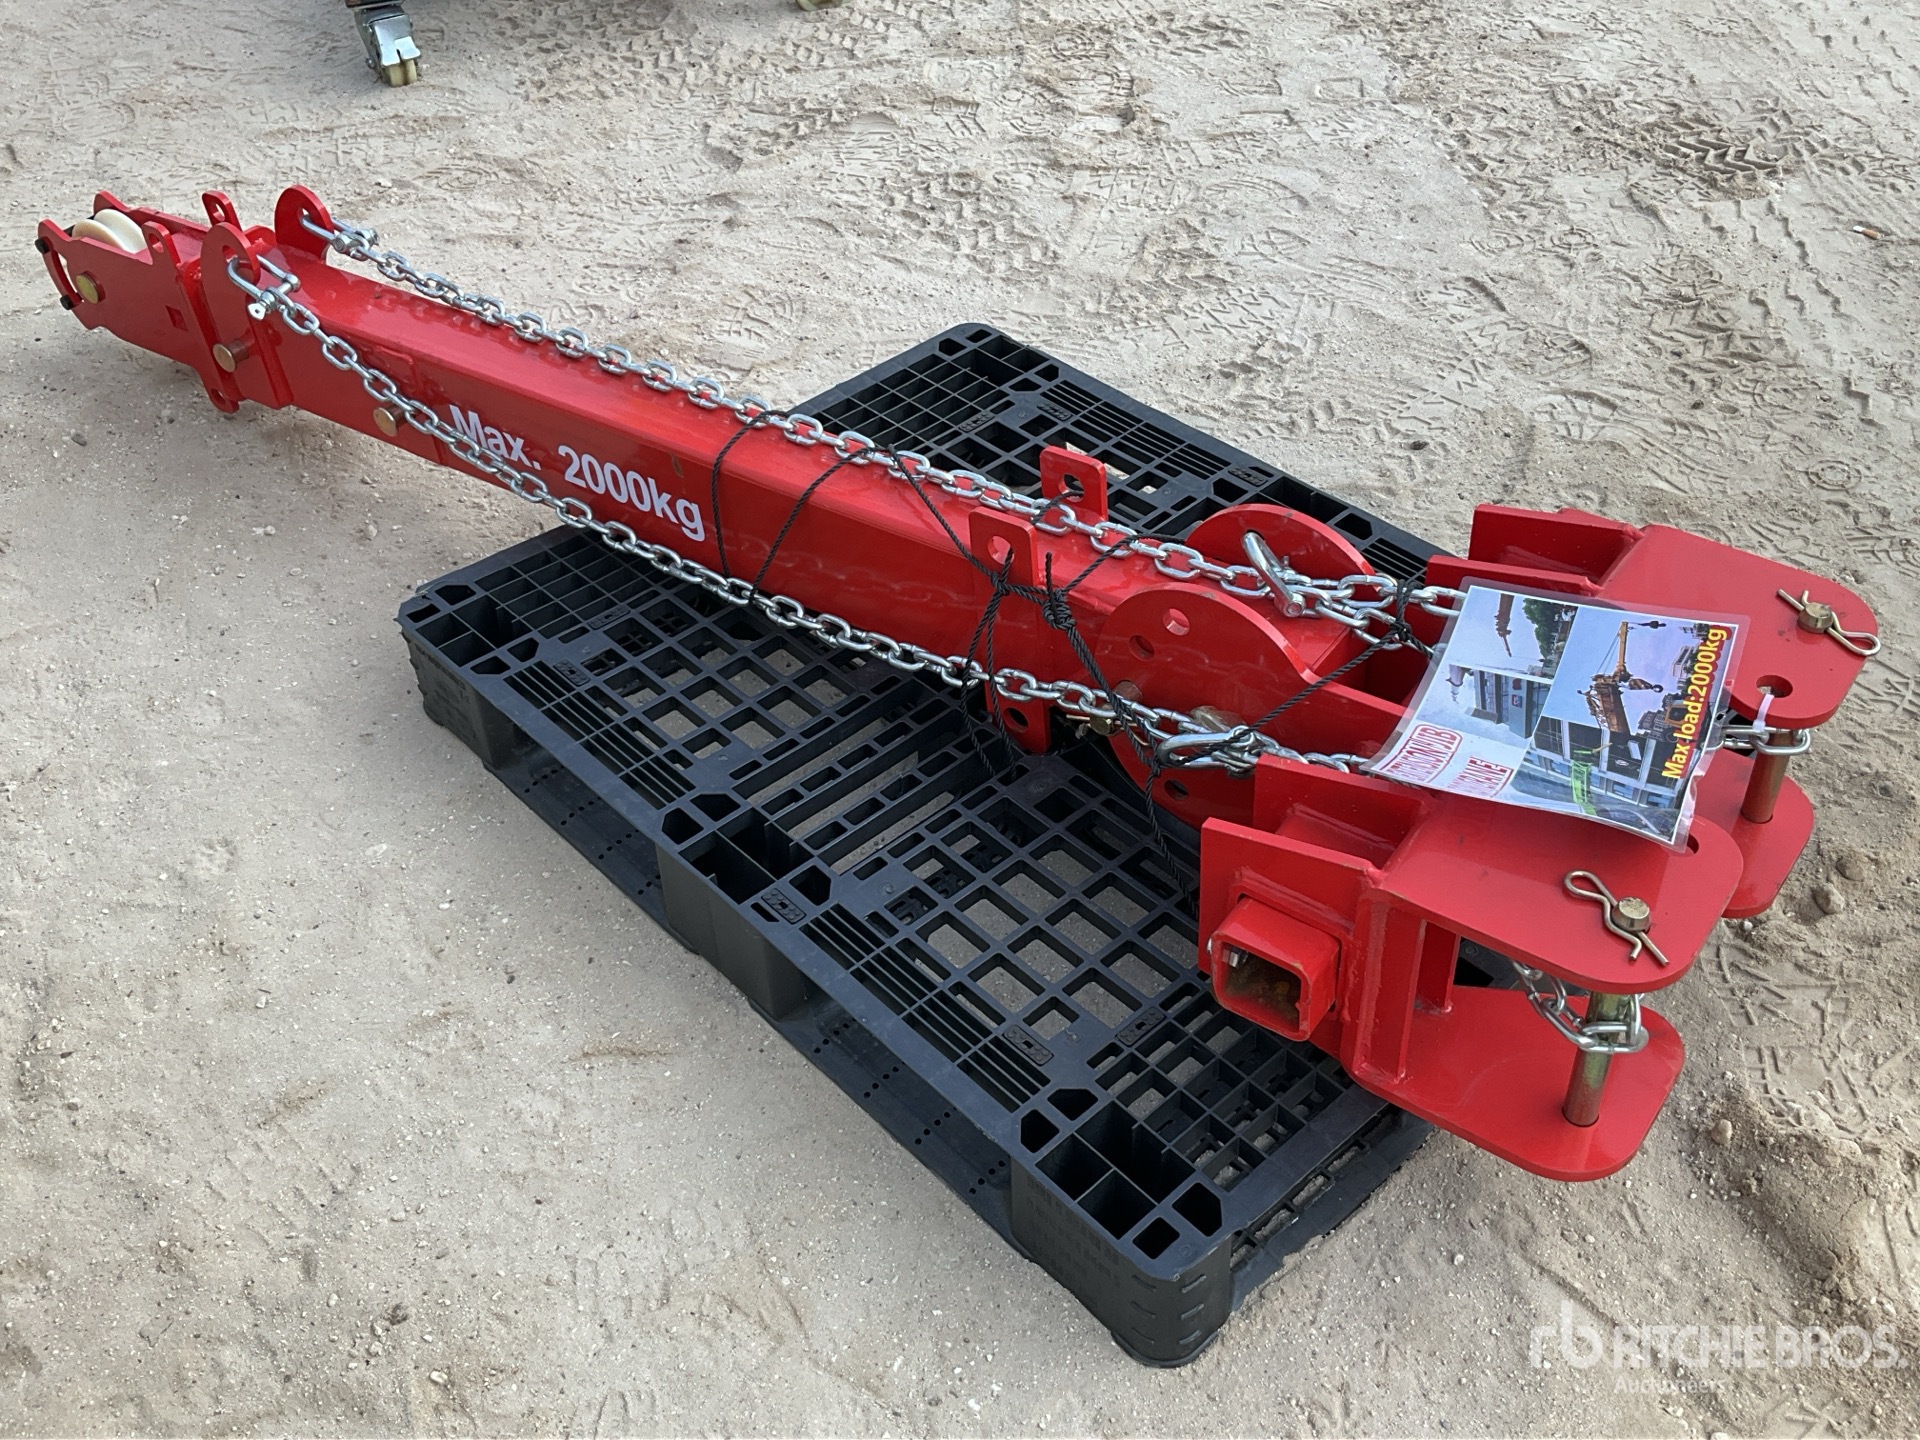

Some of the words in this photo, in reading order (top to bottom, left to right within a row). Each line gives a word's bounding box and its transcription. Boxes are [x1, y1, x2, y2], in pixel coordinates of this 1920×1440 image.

[449, 404, 541, 471] Max.
[558, 445, 705, 541] 2000kg
[1673, 628, 1728, 741] load:2000kg
[1661, 742, 1687, 780] Max
